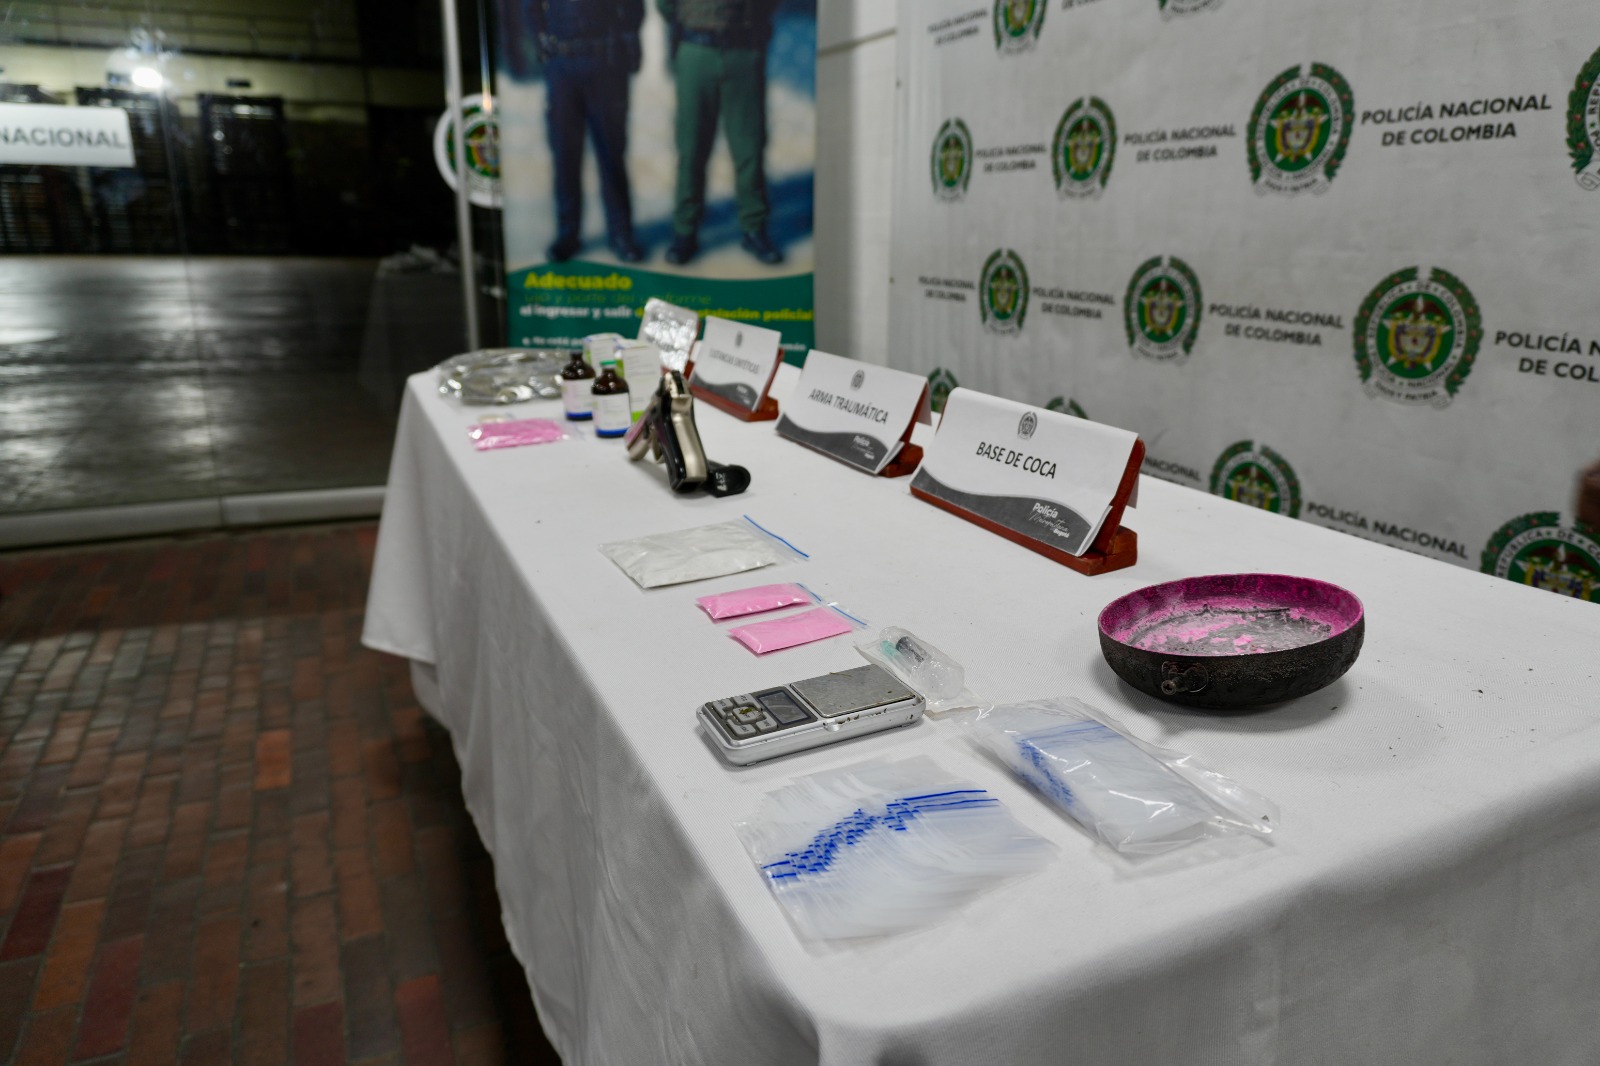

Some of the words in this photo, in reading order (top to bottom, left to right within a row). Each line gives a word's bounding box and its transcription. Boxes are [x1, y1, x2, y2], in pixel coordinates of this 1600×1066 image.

[1361, 101, 1433, 125] POLICÍA
[1439, 94, 1552, 119] NACIONAL
[1124, 128, 1167, 145] POLICÍA
[1170, 124, 1236, 142] NACIONAL
[1381, 130, 1406, 147] DE
[1410, 122, 1517, 145] COLOMBIA
[1136, 149, 1151, 163] DE
[1153, 145, 1218, 162] COLOMBIA
[524, 271, 632, 291] Adecuado
[1033, 286, 1064, 299] POLICÍA
[1066, 289, 1116, 306] NACIONAL
[533, 303, 590, 320] ingresar
[592, 307, 601, 320] y
[604, 304, 632, 318] salir
[763, 307, 813, 322] policial
[1042, 302, 1052, 313] DE
[1054, 304, 1102, 319] COLOMBIA
[1209, 303, 1261, 319] POLICÍA
[1265, 308, 1344, 330] NACIONAL
[1224, 323, 1241, 337] DE
[1244, 325, 1322, 346] COLOMBIA
[1495, 331, 1582, 355] POLICÍA
[1518, 357, 1547, 375] DE
[808, 388, 833, 407] ARMA
[833, 396, 889, 425] TRAUMÁTICA
[976, 441, 1005, 462] BASE
[1004, 450, 1023, 468] DE
[1022, 456, 1057, 479] COCA
[1144, 457, 1200, 482] NACIONAL
[1033, 502, 1058, 518] Policía
[1307, 502, 1368, 529] POLICÍA
[1373, 520, 1468, 560] NACIONAL
[1557, 529, 1575, 540] DE
